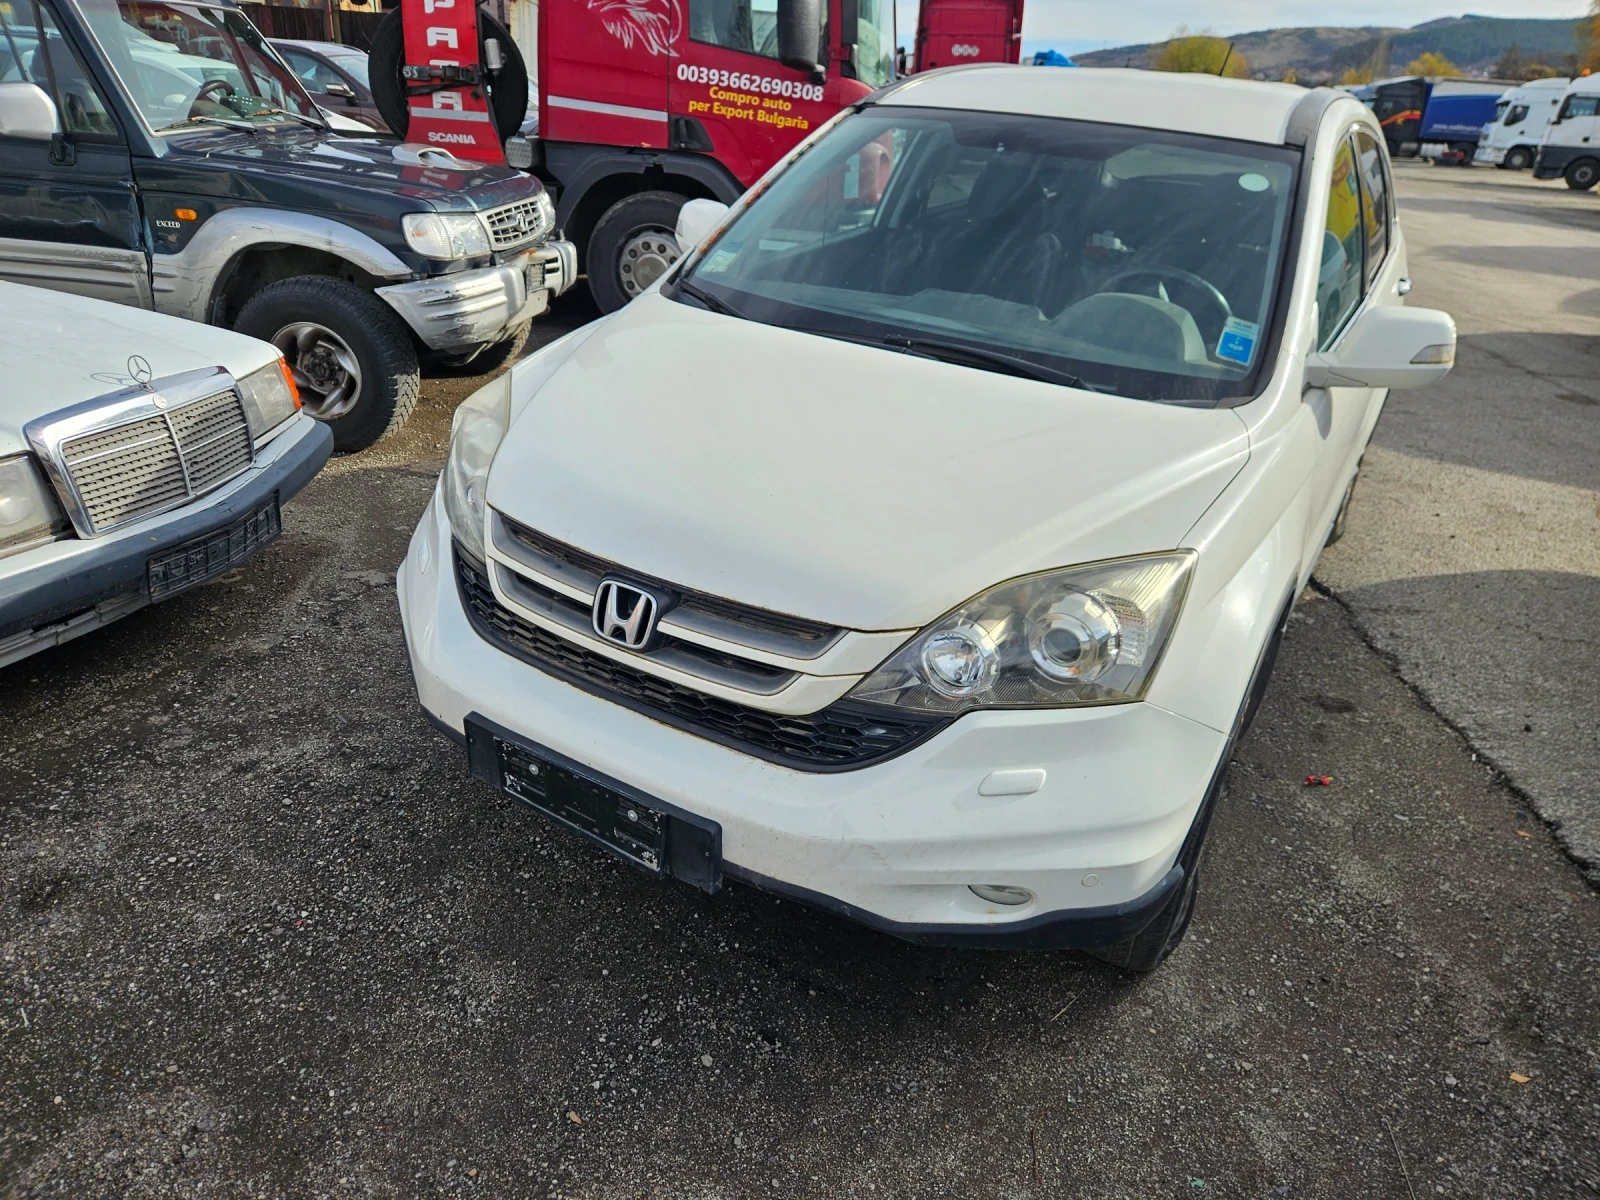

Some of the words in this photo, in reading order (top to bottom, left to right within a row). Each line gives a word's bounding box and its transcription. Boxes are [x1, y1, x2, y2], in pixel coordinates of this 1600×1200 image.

[676, 63, 824, 102] 00393662690308
[709, 86, 760, 106] Compro
[762, 97, 792, 111] auto
[688, 100, 711, 112] per
[713, 103, 754, 119] Export
[757, 111, 809, 129] Bulgaria
[428, 131, 476, 145] SCANIA
[156, 220, 181, 229] EXCEED
